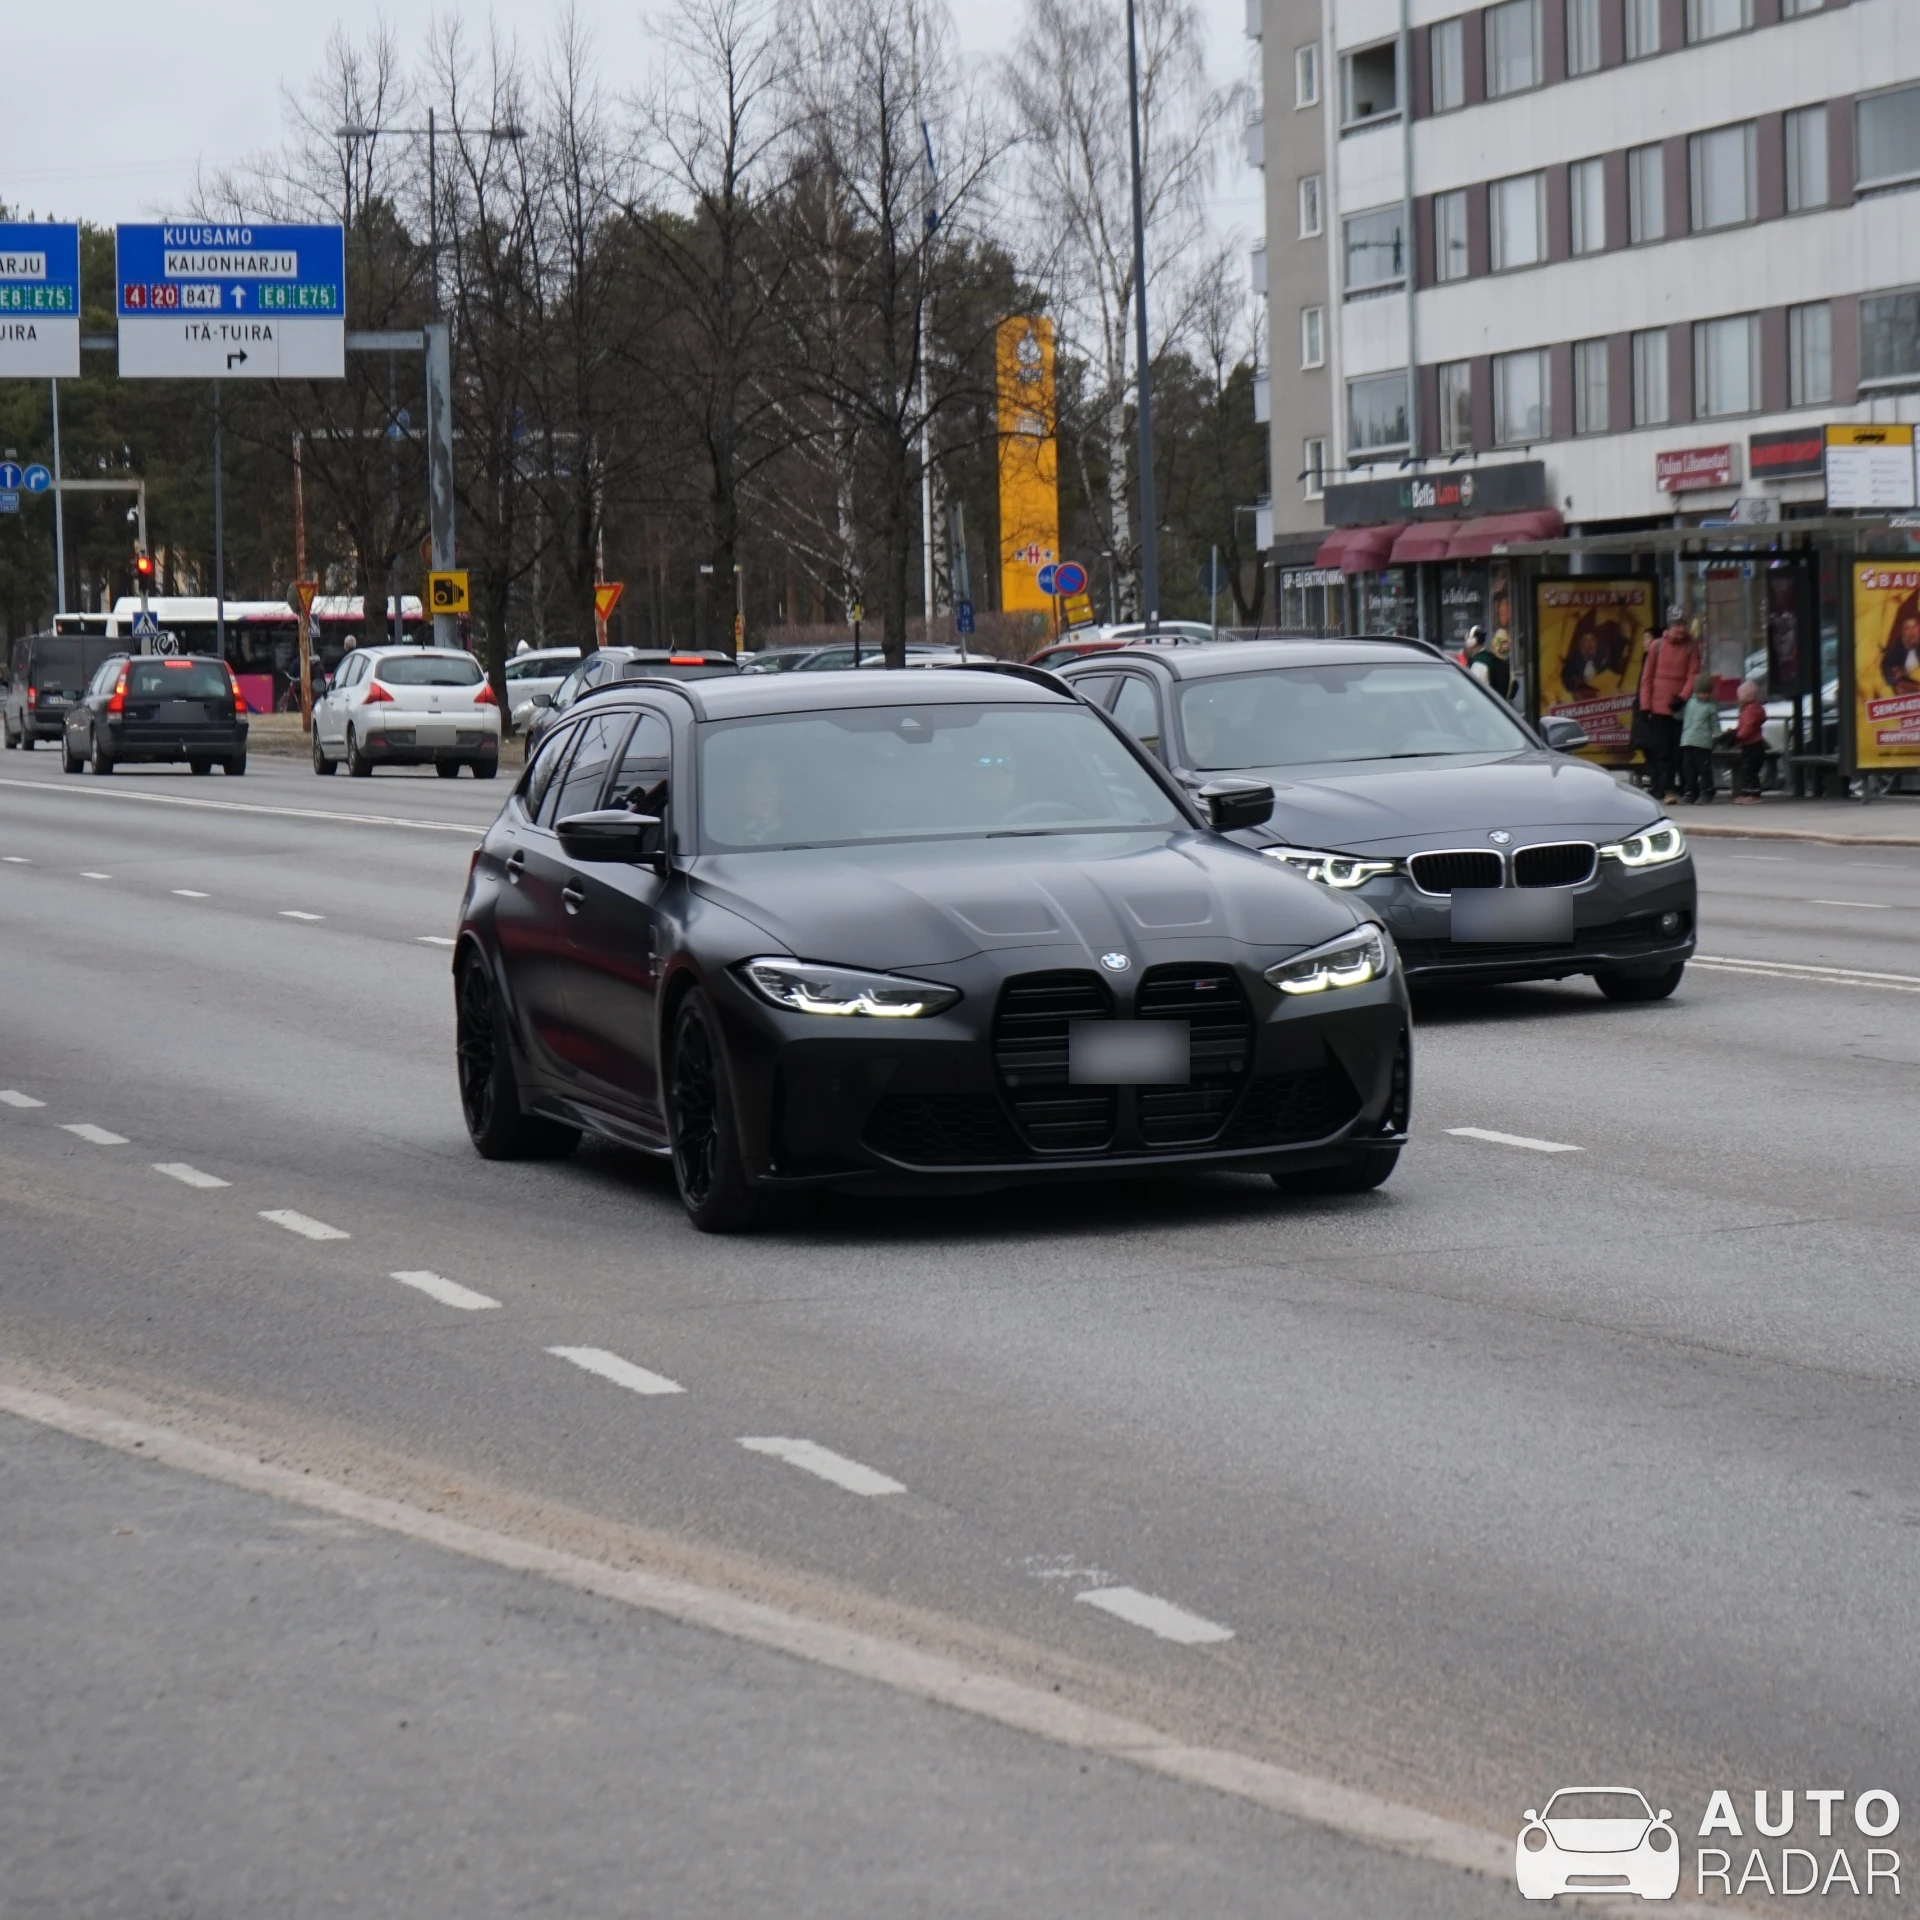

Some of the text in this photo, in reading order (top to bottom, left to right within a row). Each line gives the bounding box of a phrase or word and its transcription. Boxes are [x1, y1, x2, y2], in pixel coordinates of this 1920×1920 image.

[163, 227, 252, 245] KUUSAMO
[167, 254, 293, 273] KAIJONHARJU
[1, 288, 66, 307] E8 E75
[129, 286, 330, 307] 4 20 847 E8 E75
[184, 320, 274, 341] ITÄ-TUIRA
[1411, 479, 1436, 509] Bella
